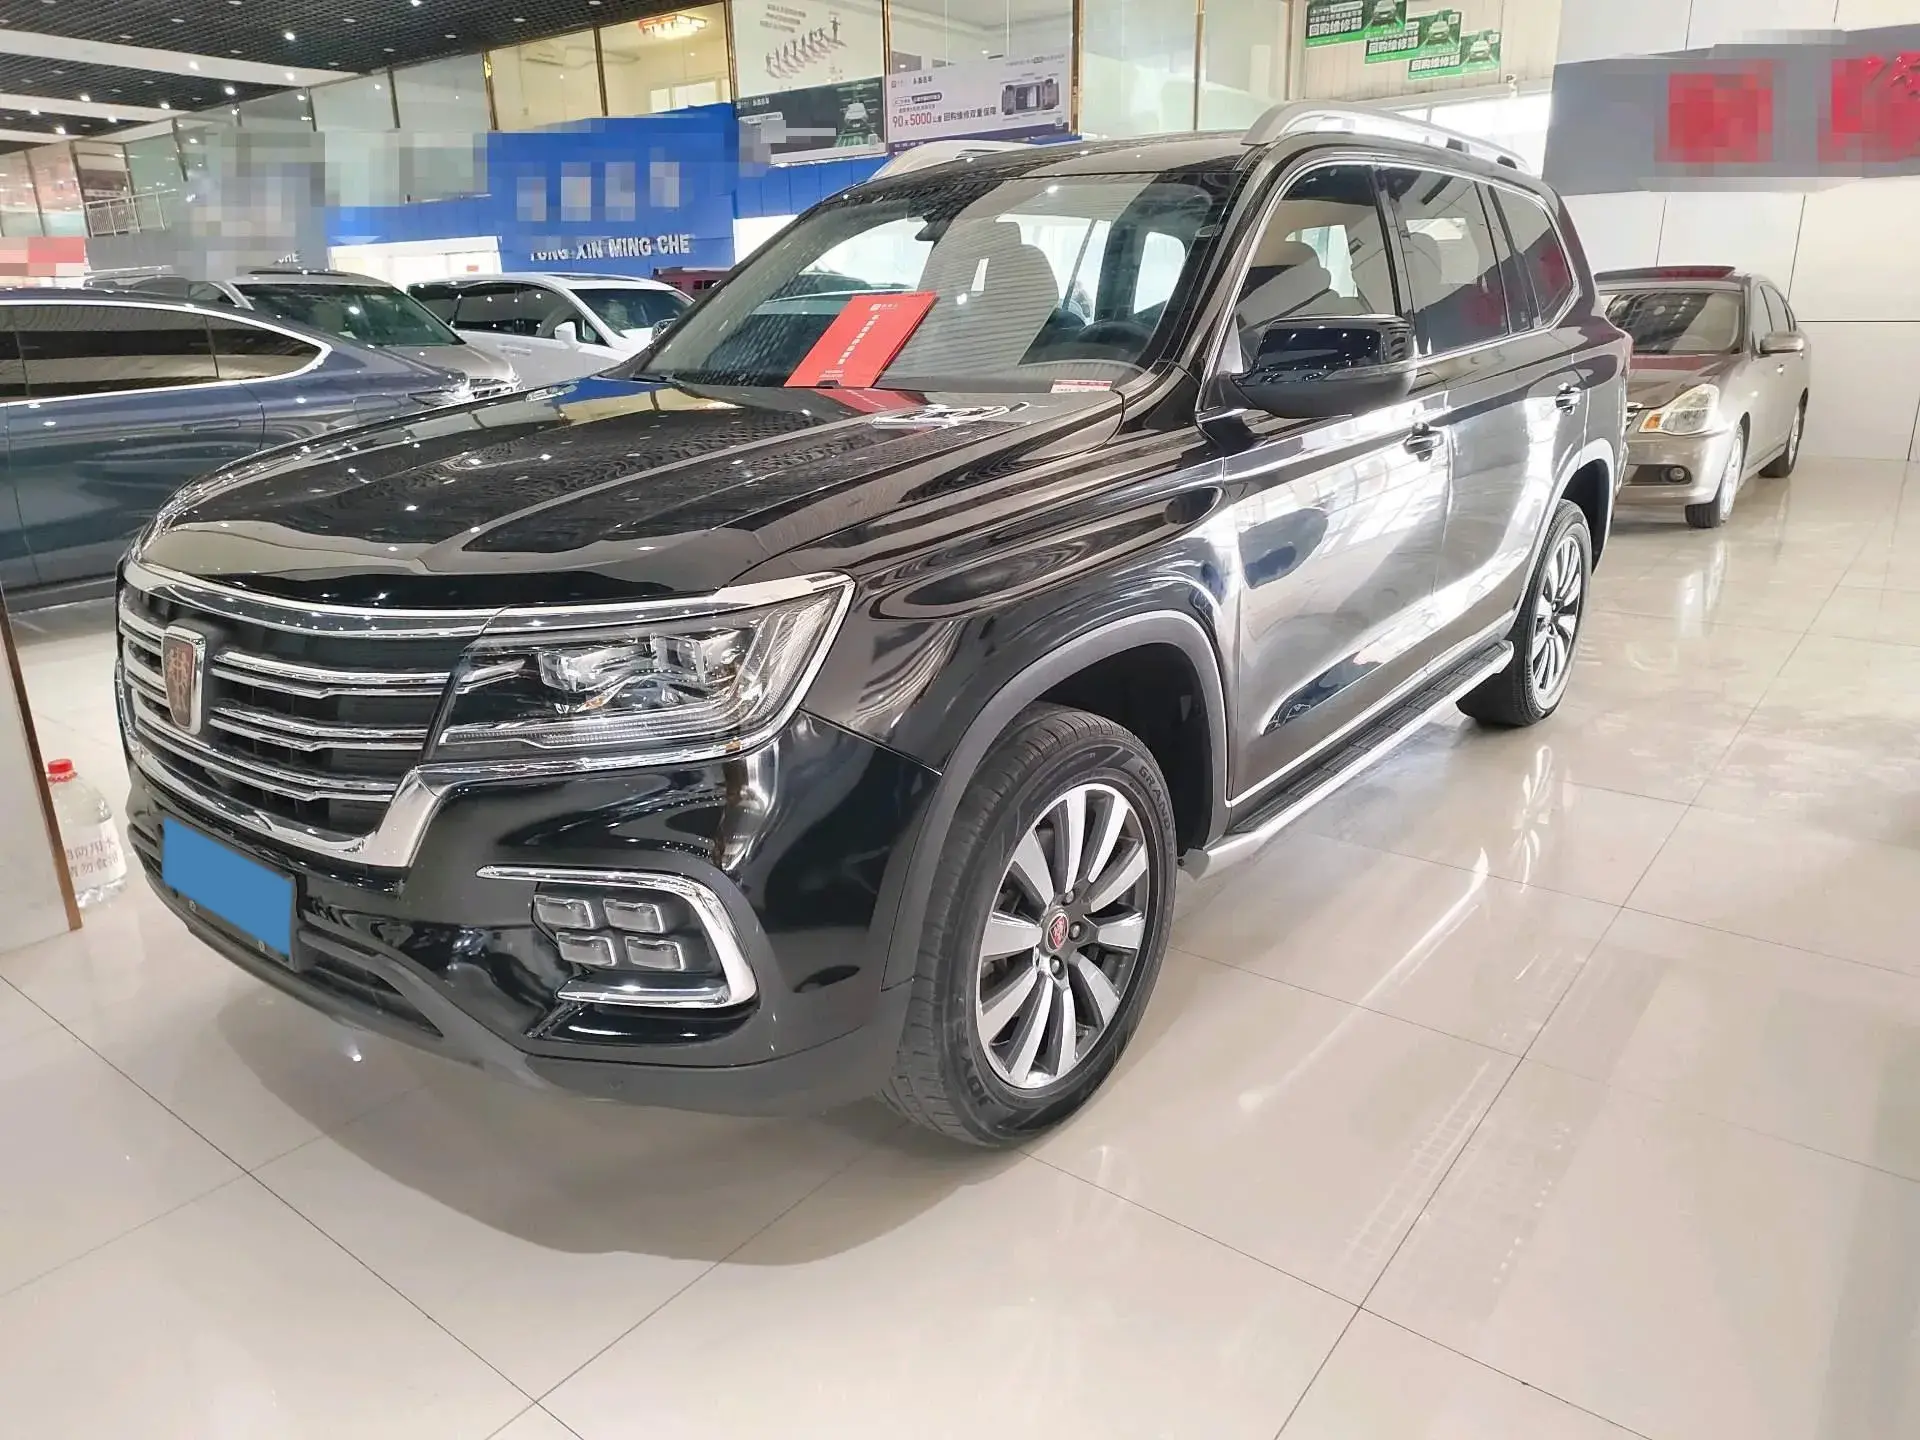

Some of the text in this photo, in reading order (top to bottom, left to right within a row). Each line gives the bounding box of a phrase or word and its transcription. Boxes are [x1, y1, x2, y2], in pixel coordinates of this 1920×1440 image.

[608, 237, 650, 258] MING
[656, 233, 690, 254] CHE
[1138, 766, 1171, 831] GRAND
